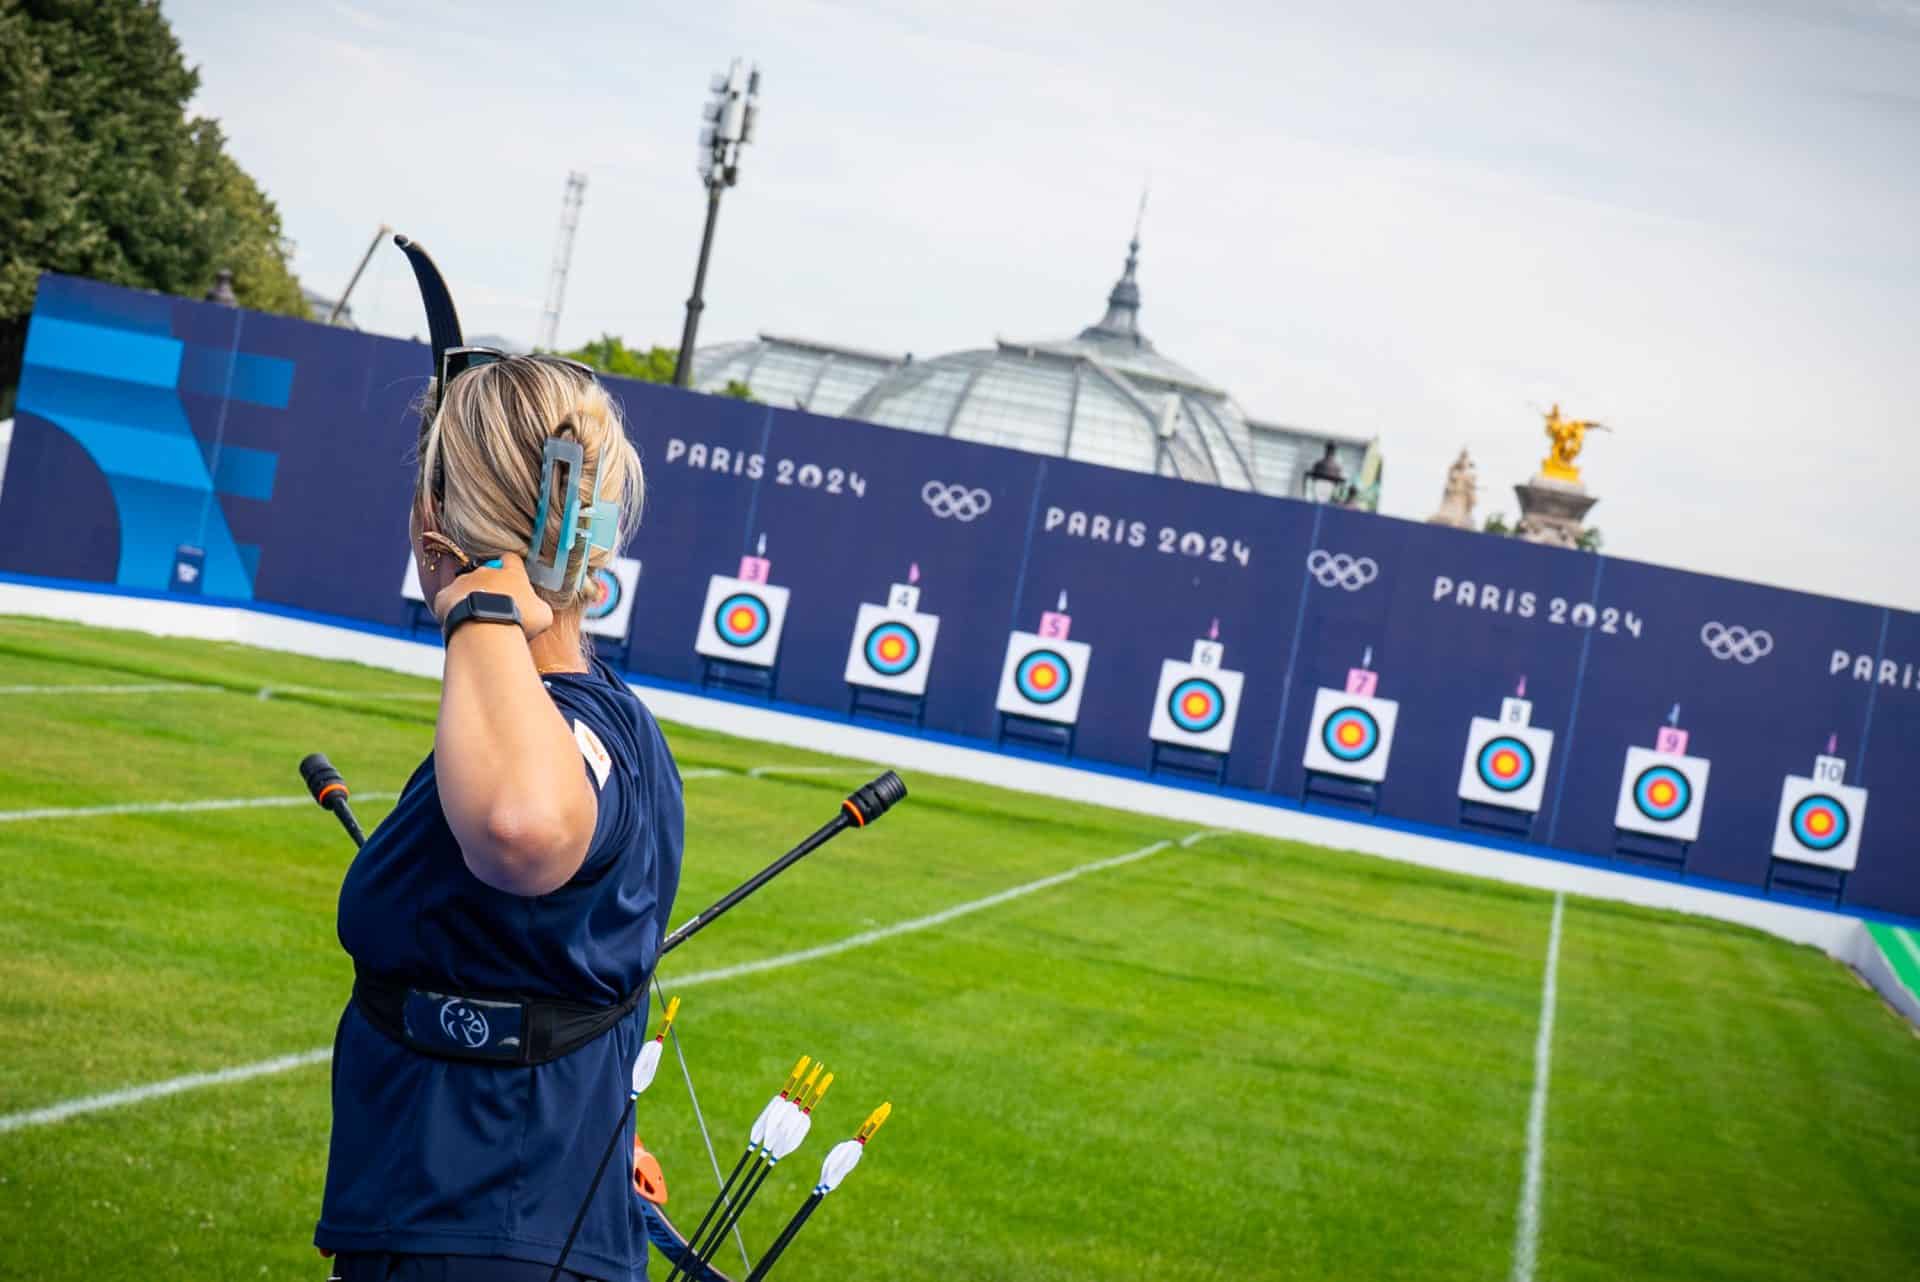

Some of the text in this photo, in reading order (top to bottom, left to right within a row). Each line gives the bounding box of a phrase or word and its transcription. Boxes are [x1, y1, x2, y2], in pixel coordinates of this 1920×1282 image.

[666, 438, 867, 498] PARIS 2024
[1045, 506, 1250, 567] PARIS 2024
[748, 562, 760, 581] 3
[897, 590, 910, 607] 4
[1433, 576, 1643, 638] PARIS 2024
[1048, 617, 1061, 638] 5
[1200, 646, 1216, 665] 6
[1830, 649, 1920, 691] PARI
[1355, 674, 1369, 695] 7
[1509, 703, 1523, 723] 8
[1664, 733, 1680, 753] 9
[1820, 761, 1843, 782] 10
